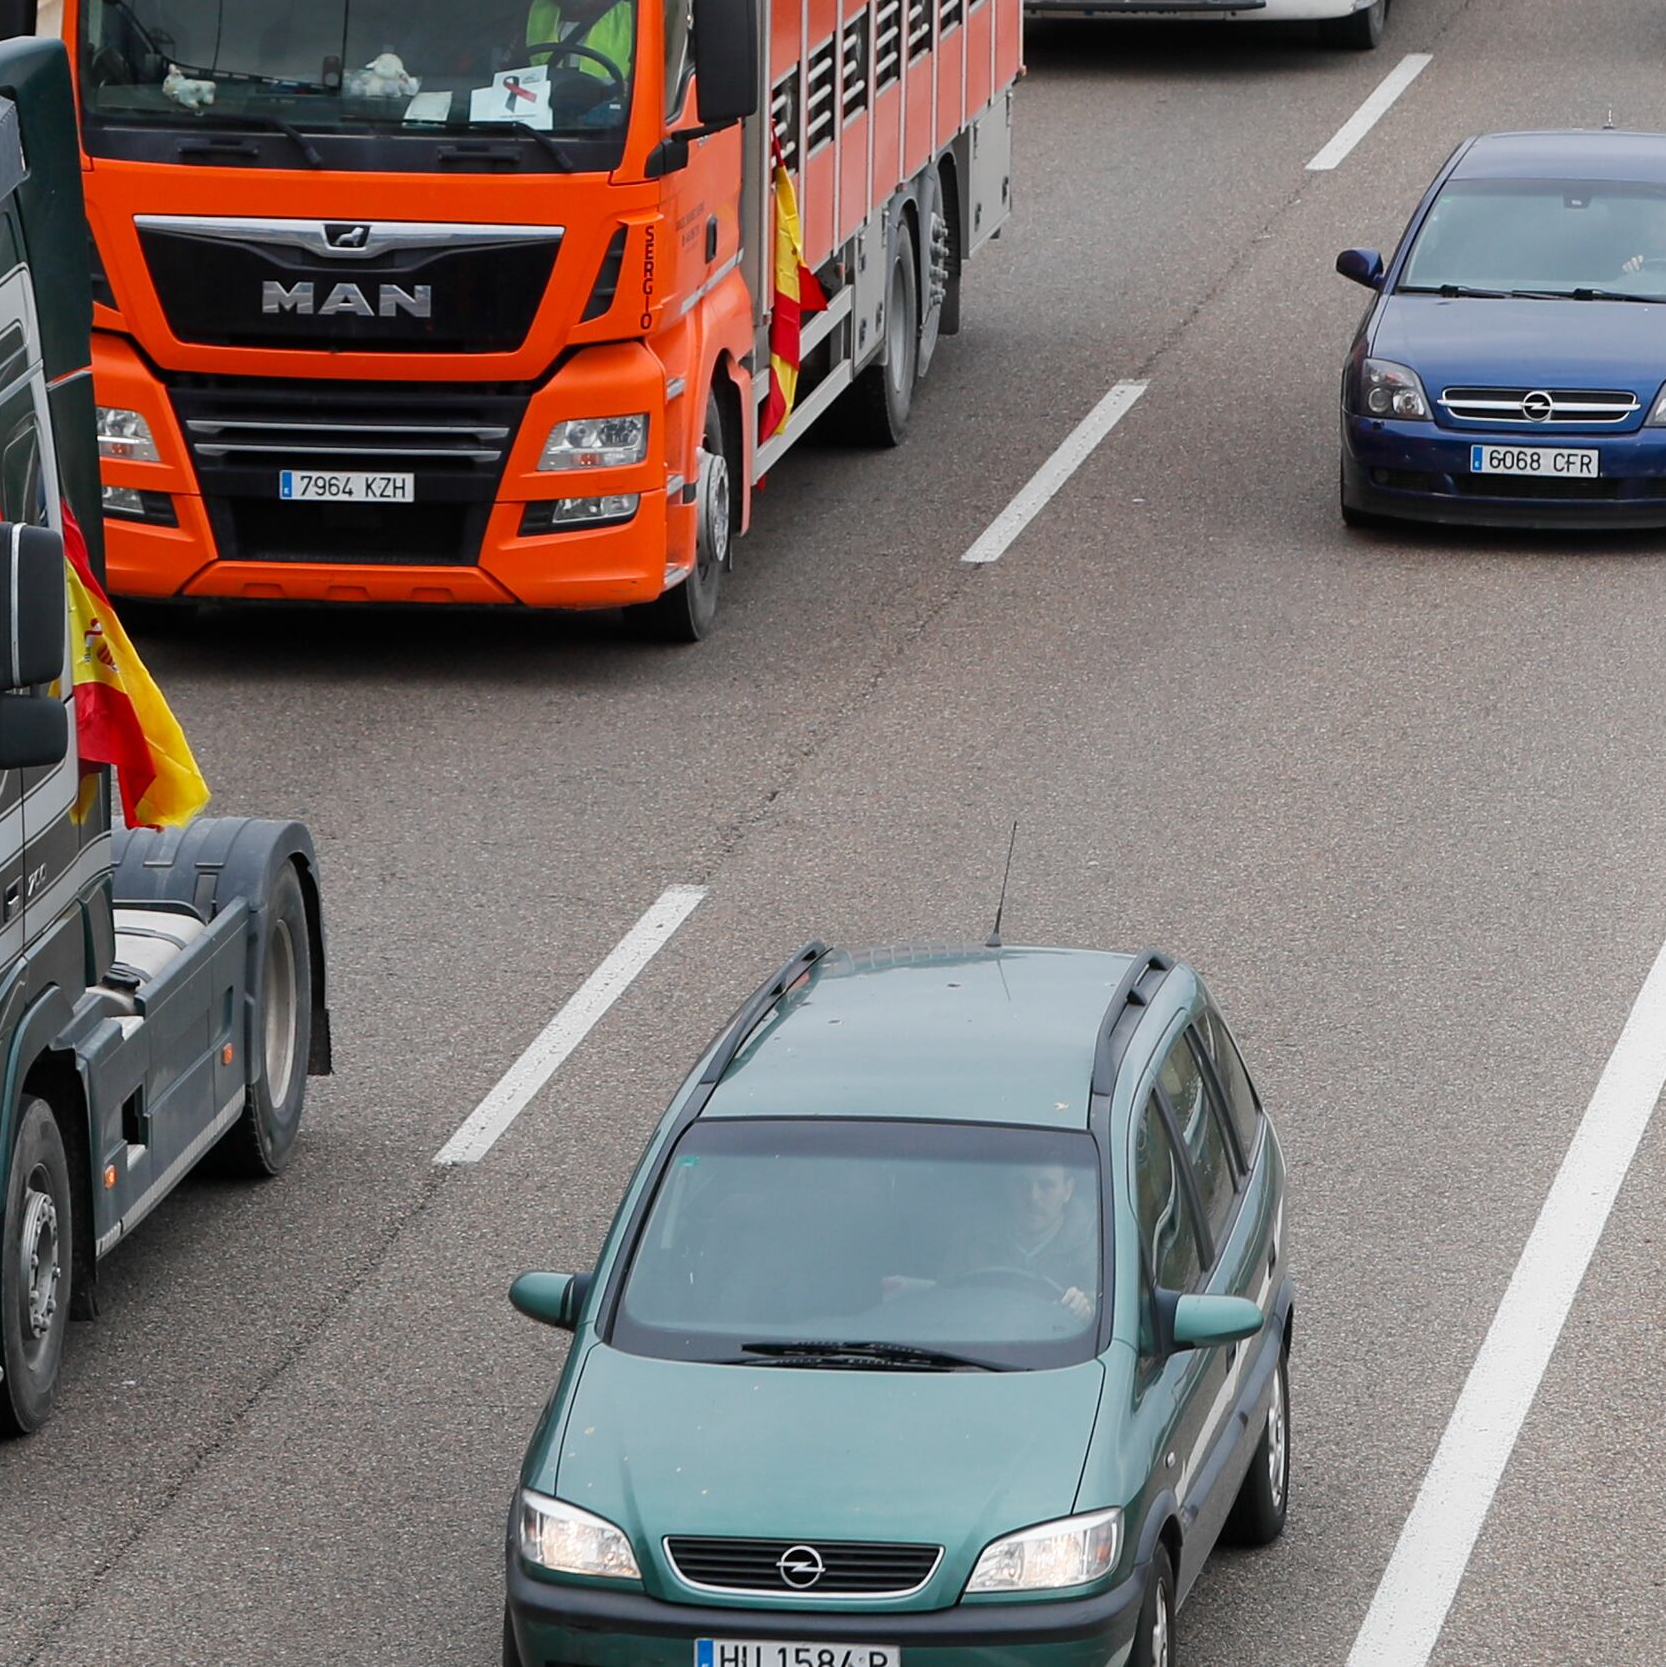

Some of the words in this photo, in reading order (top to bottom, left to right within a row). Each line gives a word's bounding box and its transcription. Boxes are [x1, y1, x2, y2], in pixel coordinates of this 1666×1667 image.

[639, 224, 655, 330] SERGIO
[262, 280, 432, 318] MAN
[1489, 449, 1542, 471] 6068
[1553, 452, 1593, 474] CFR
[299, 476, 354, 497] 7964
[365, 476, 407, 498] KZH
